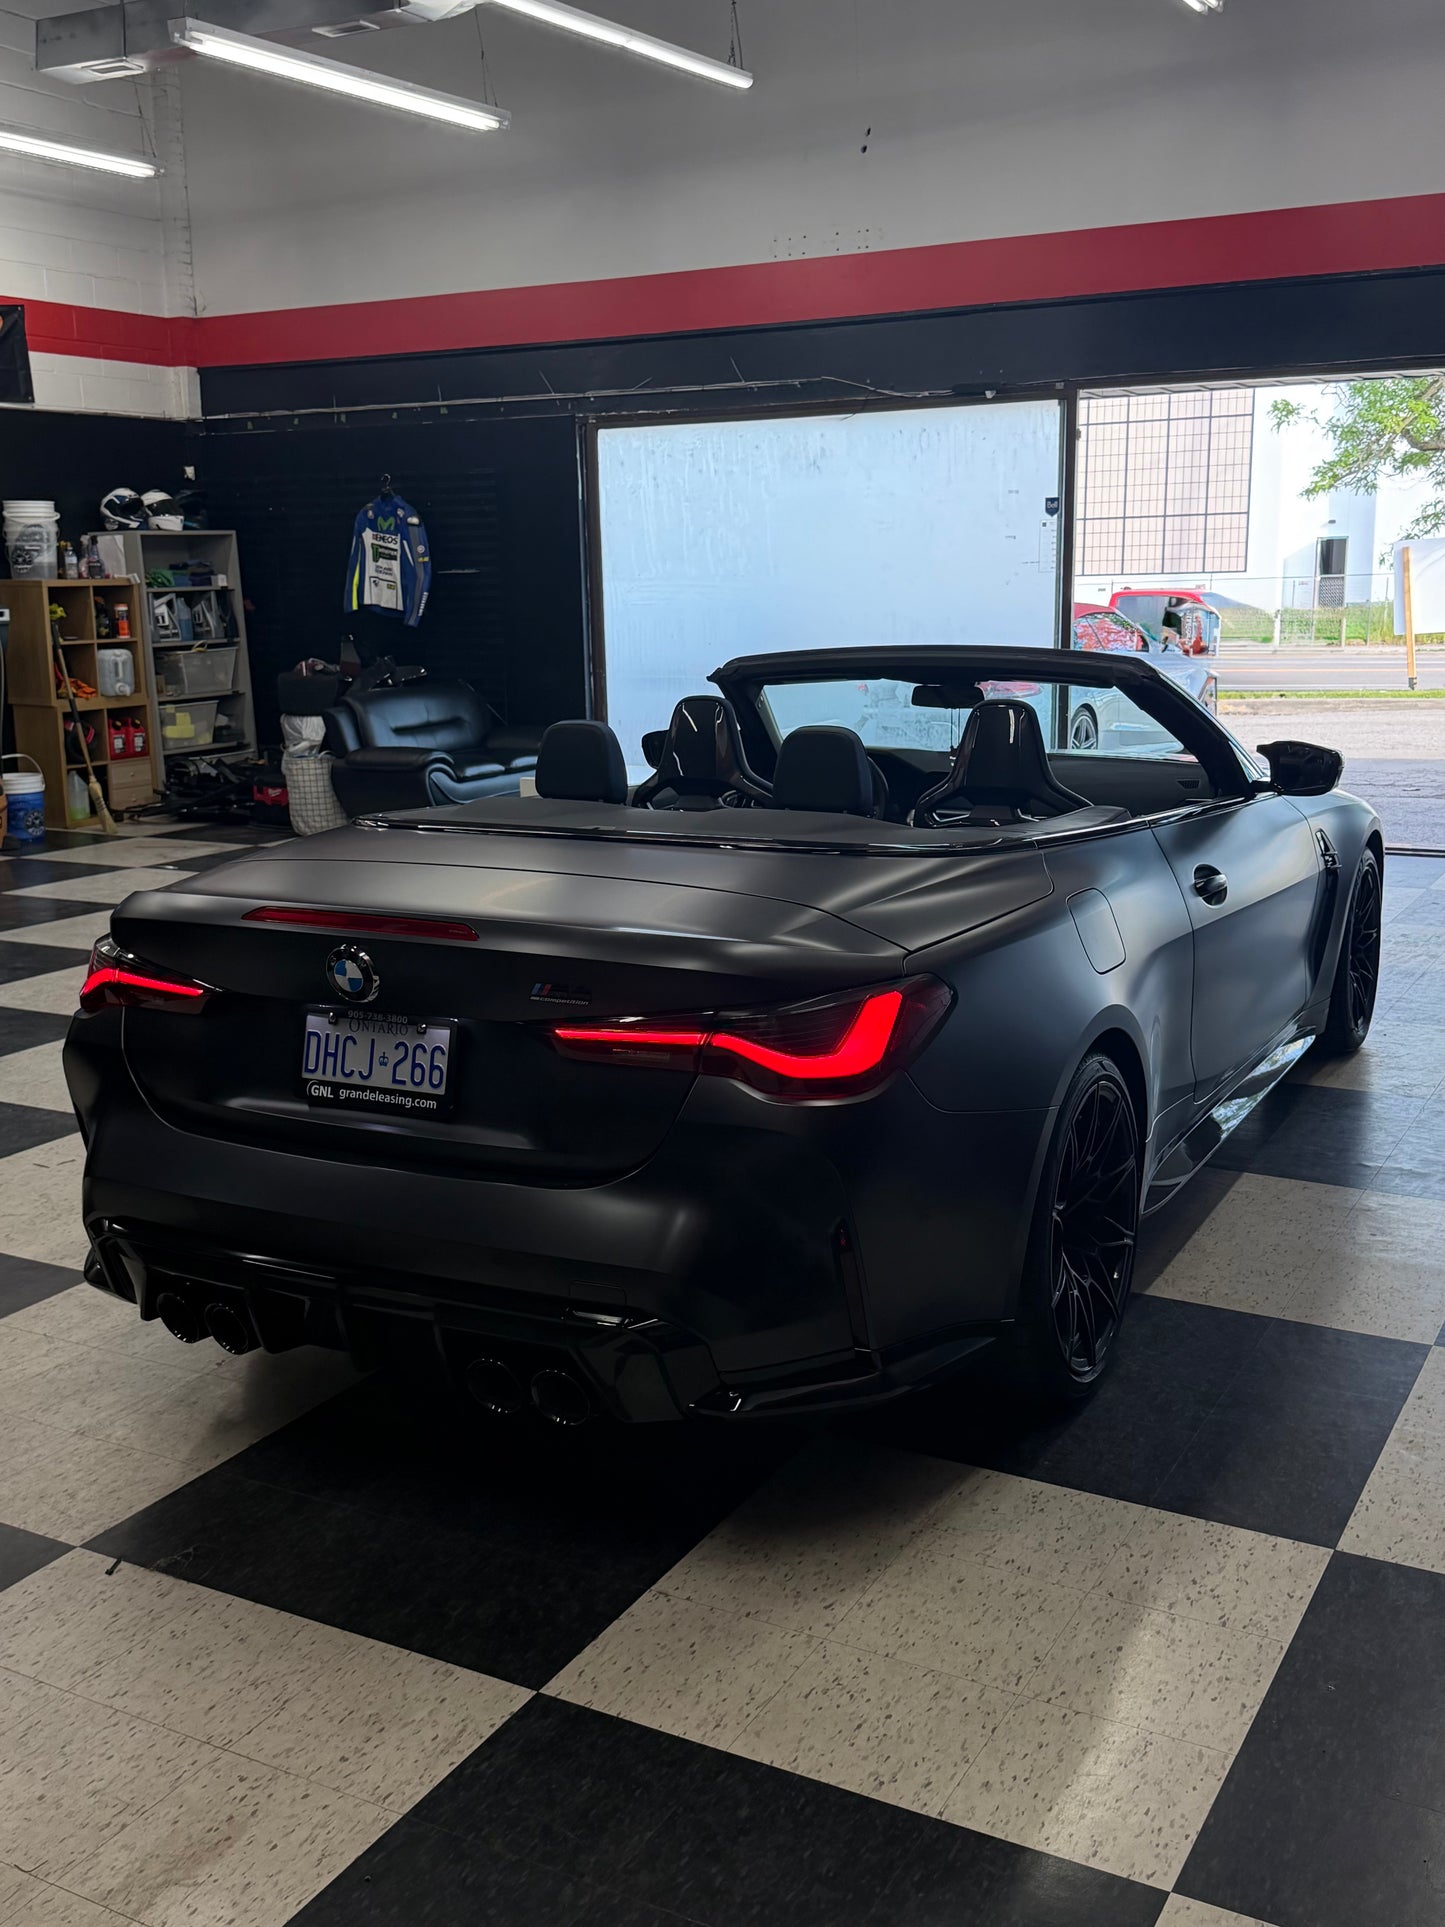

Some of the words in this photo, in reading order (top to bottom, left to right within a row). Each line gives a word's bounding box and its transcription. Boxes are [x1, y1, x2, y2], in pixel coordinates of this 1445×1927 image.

[349, 1019, 409, 1036] ONTARIO
[304, 1029, 376, 1081] DHCJ
[391, 1040, 447, 1090] 266
[310, 1084, 334, 1099] GNL
[338, 1088, 438, 1110] grandeleasing.com
